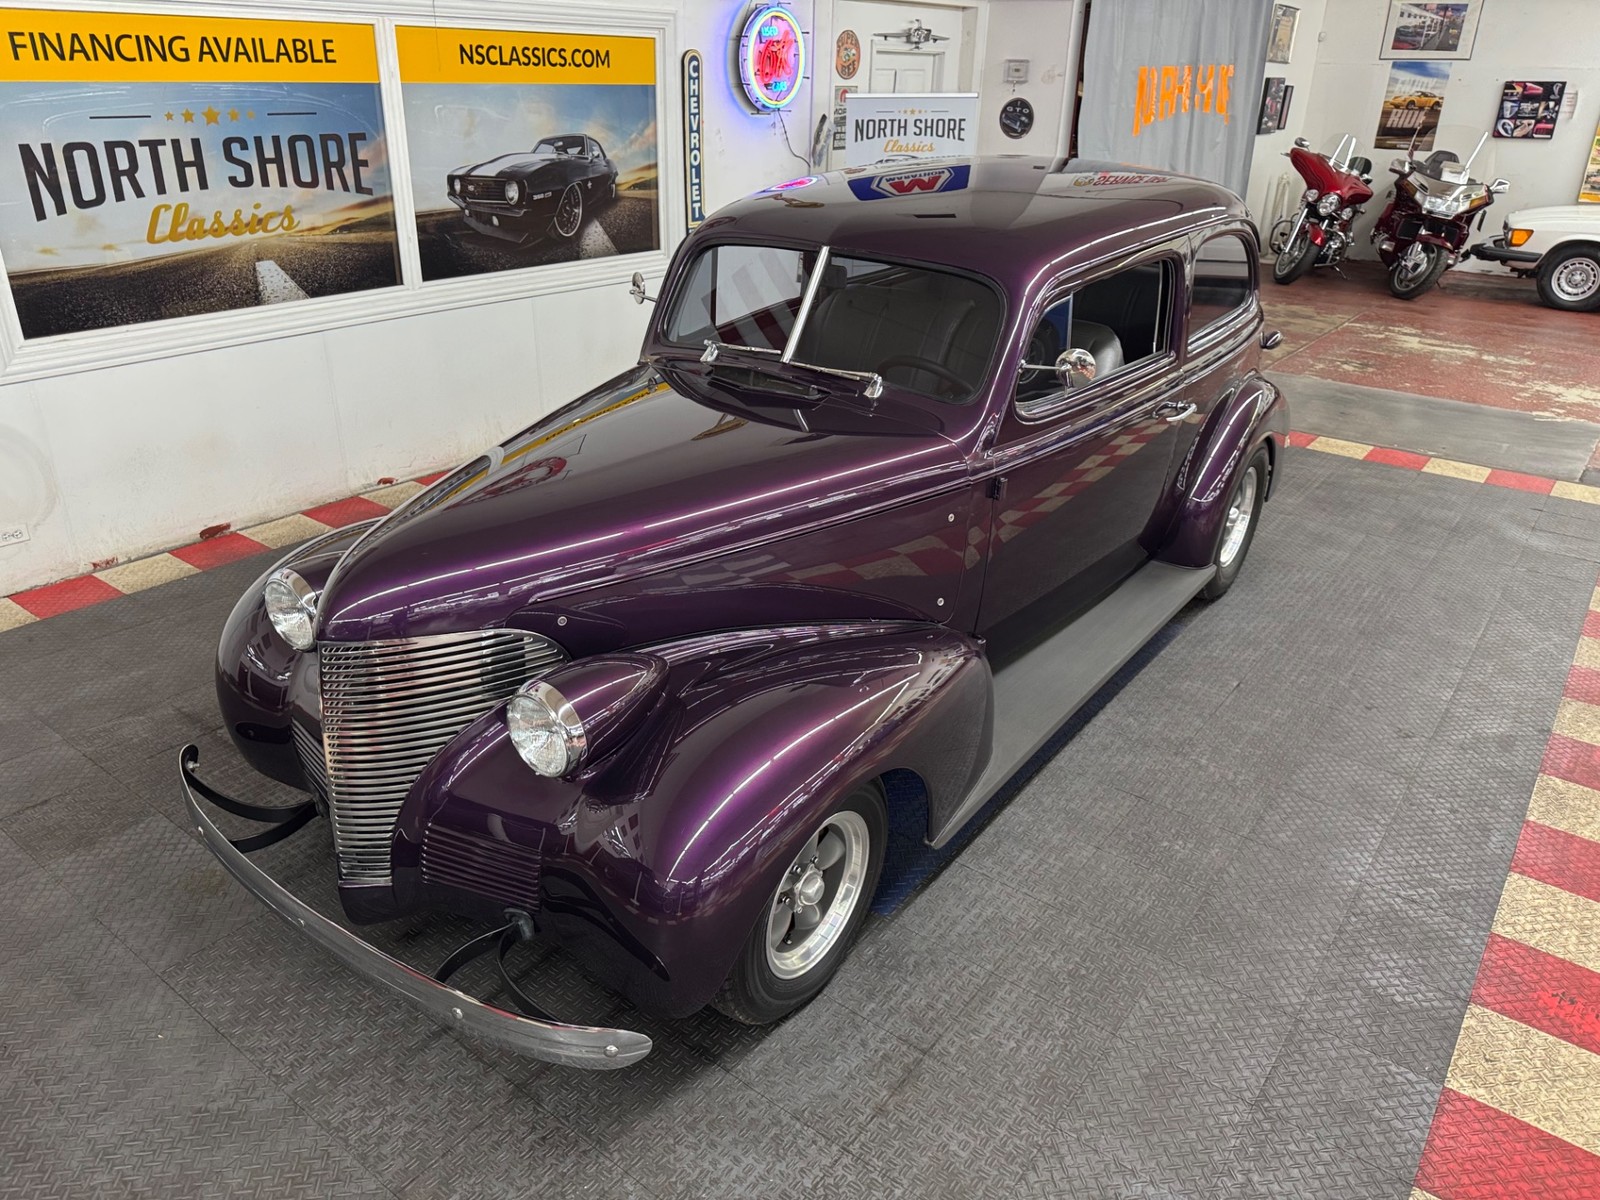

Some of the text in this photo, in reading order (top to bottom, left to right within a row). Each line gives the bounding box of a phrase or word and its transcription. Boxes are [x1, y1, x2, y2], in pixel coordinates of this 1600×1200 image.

[7, 31, 337, 63] FINANCING AVAILABLE
[459, 44, 611, 68] NSCLASSICS.COM
[689, 60, 702, 218] CHEVROLET
[854, 118, 908, 143] NORTH
[913, 118, 966, 142] SHORE
[883, 139, 936, 153] Classics
[18, 131, 375, 222] NORTH SHORE
[146, 201, 300, 245] Classics
